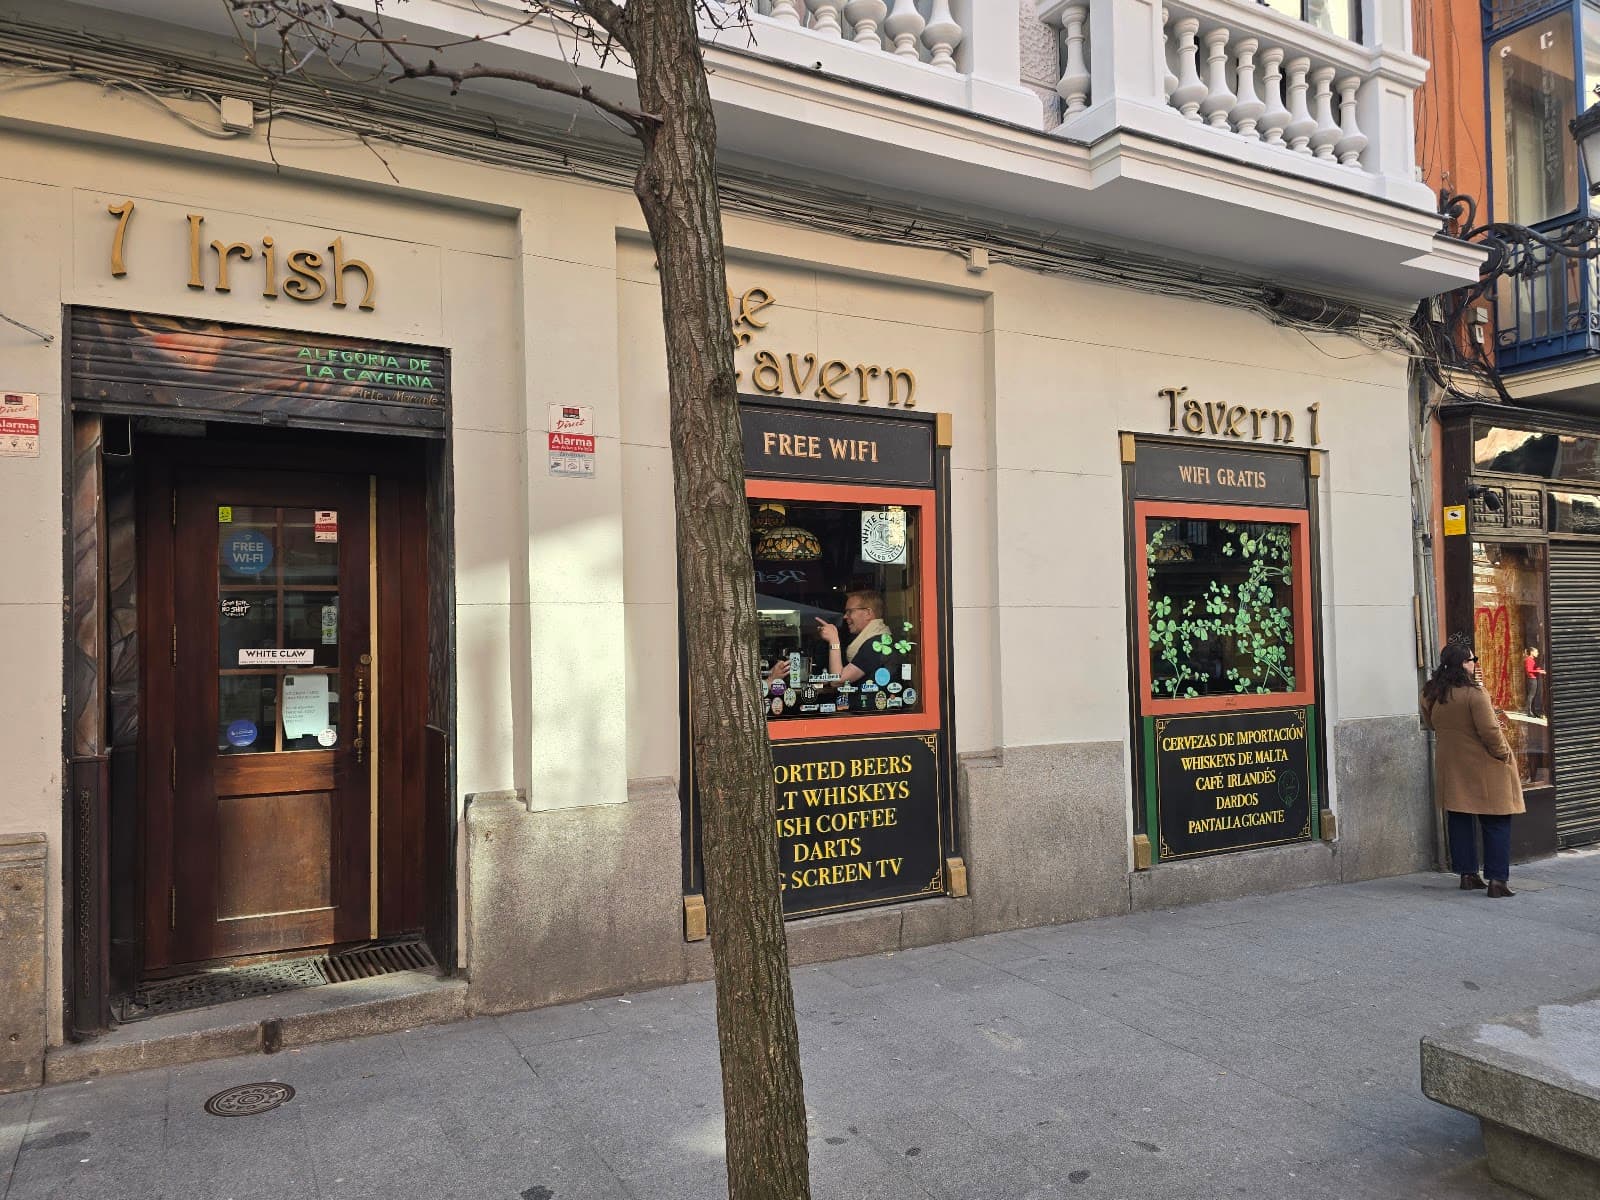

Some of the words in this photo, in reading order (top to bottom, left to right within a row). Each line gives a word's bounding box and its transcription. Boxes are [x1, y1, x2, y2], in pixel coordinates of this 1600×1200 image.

[186, 213, 377, 312] Irish
[297, 347, 400, 369] ALEGORIA
[408, 358, 432, 373] DE
[305, 363, 336, 379] LA
[343, 367, 433, 389] CAVERNA
[735, 340, 917, 407] avern
[1158, 386, 1295, 443] Tavern
[551, 434, 593, 447] Alarma
[763, 431, 822, 459] FREE
[828, 437, 879, 463] WIFI
[1178, 465, 1210, 485] WIFI
[1217, 468, 1267, 488] GRATIS
[862, 514, 877, 545] WHITE
[232, 541, 264, 552] FREE
[232, 553, 264, 563] WI-FI
[246, 650, 277, 658] WHITE
[280, 650, 306, 658] CLAW
[1162, 734, 1217, 752] CERVEZAS
[1218, 732, 1235, 747] DE
[1237, 724, 1304, 745] IMPORTACIÓN
[774, 761, 846, 785] ORTED
[850, 754, 913, 778] BEERS
[1181, 753, 1236, 771] WHISKEYS
[1238, 751, 1254, 765] DE
[1255, 748, 1289, 764] MALTA
[1195, 771, 1224, 791] CAFÉ
[1227, 767, 1276, 788] IRLANDÉS
[802, 780, 911, 808] WHISKEYS
[1216, 792, 1259, 810] DARDOS
[776, 816, 812, 838] ISH
[815, 807, 898, 834] COFFEE
[1188, 815, 1242, 834] PANTALLA
[793, 837, 862, 863] DARTS
[791, 861, 872, 890] SCREEN
[875, 857, 905, 878] TV
